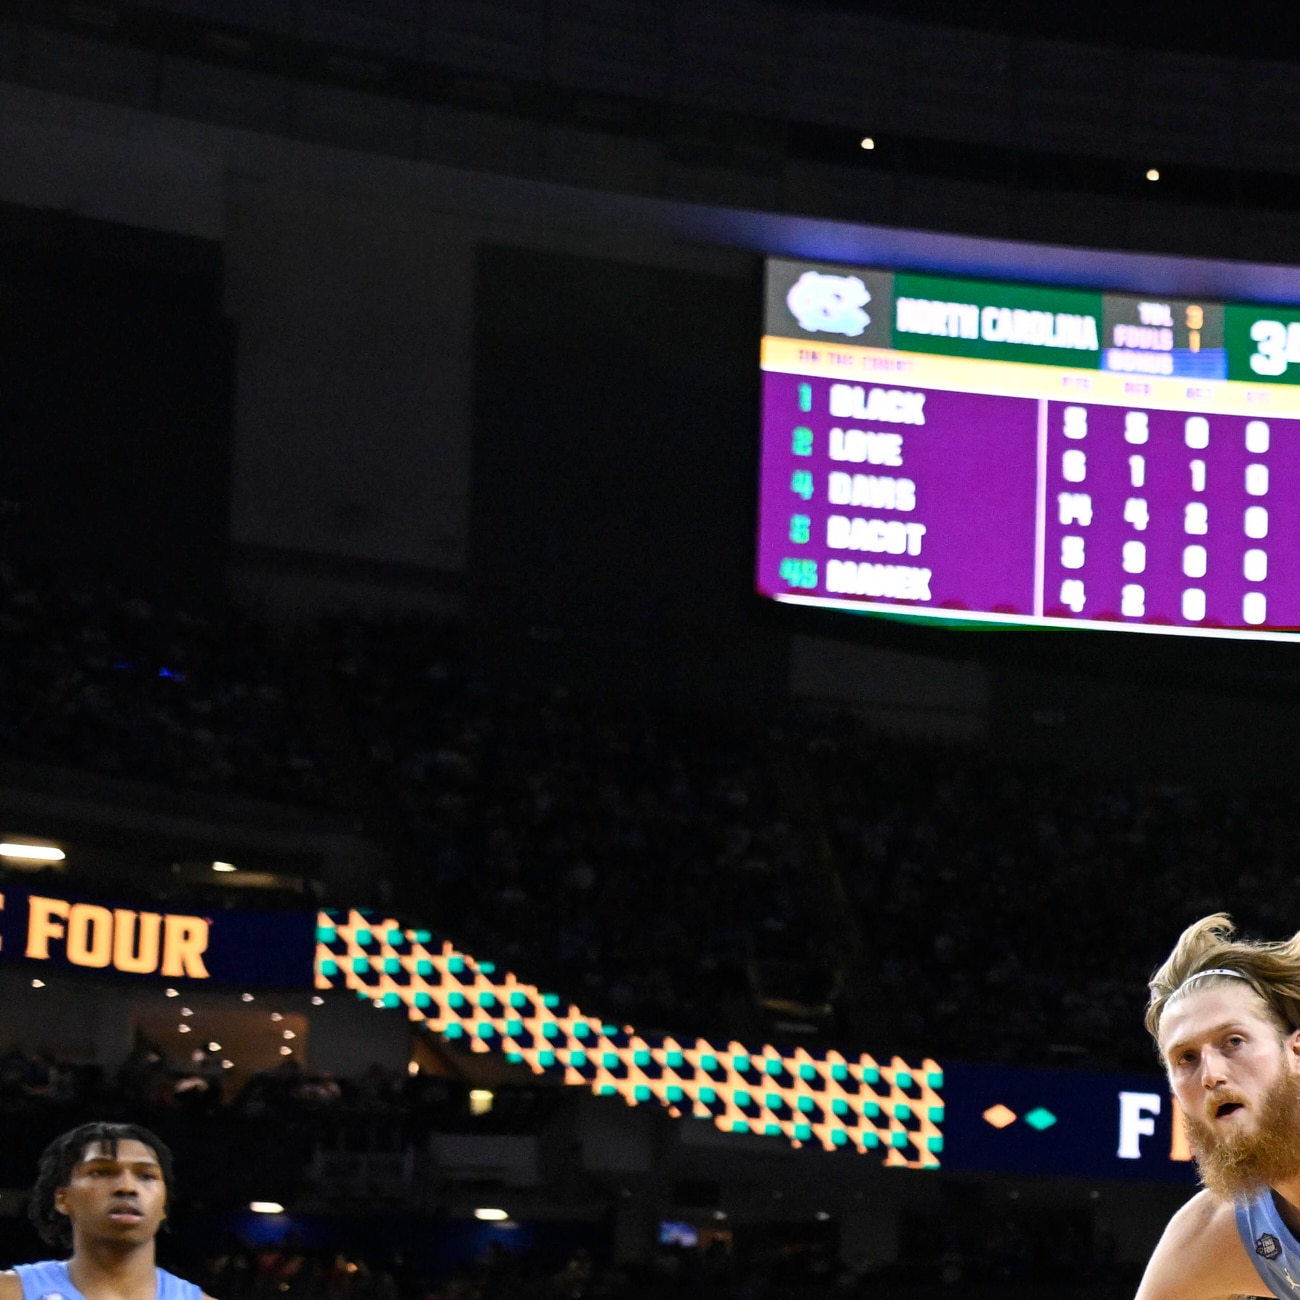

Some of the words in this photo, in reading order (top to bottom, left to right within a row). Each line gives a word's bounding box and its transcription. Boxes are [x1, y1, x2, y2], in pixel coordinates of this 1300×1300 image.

[896, 297, 979, 339] NORTH
[981, 306, 1098, 351] CAROLINA
[829, 383, 927, 426] BLACK
[829, 428, 903, 467] LOVE
[25, 894, 211, 979] FOUR
